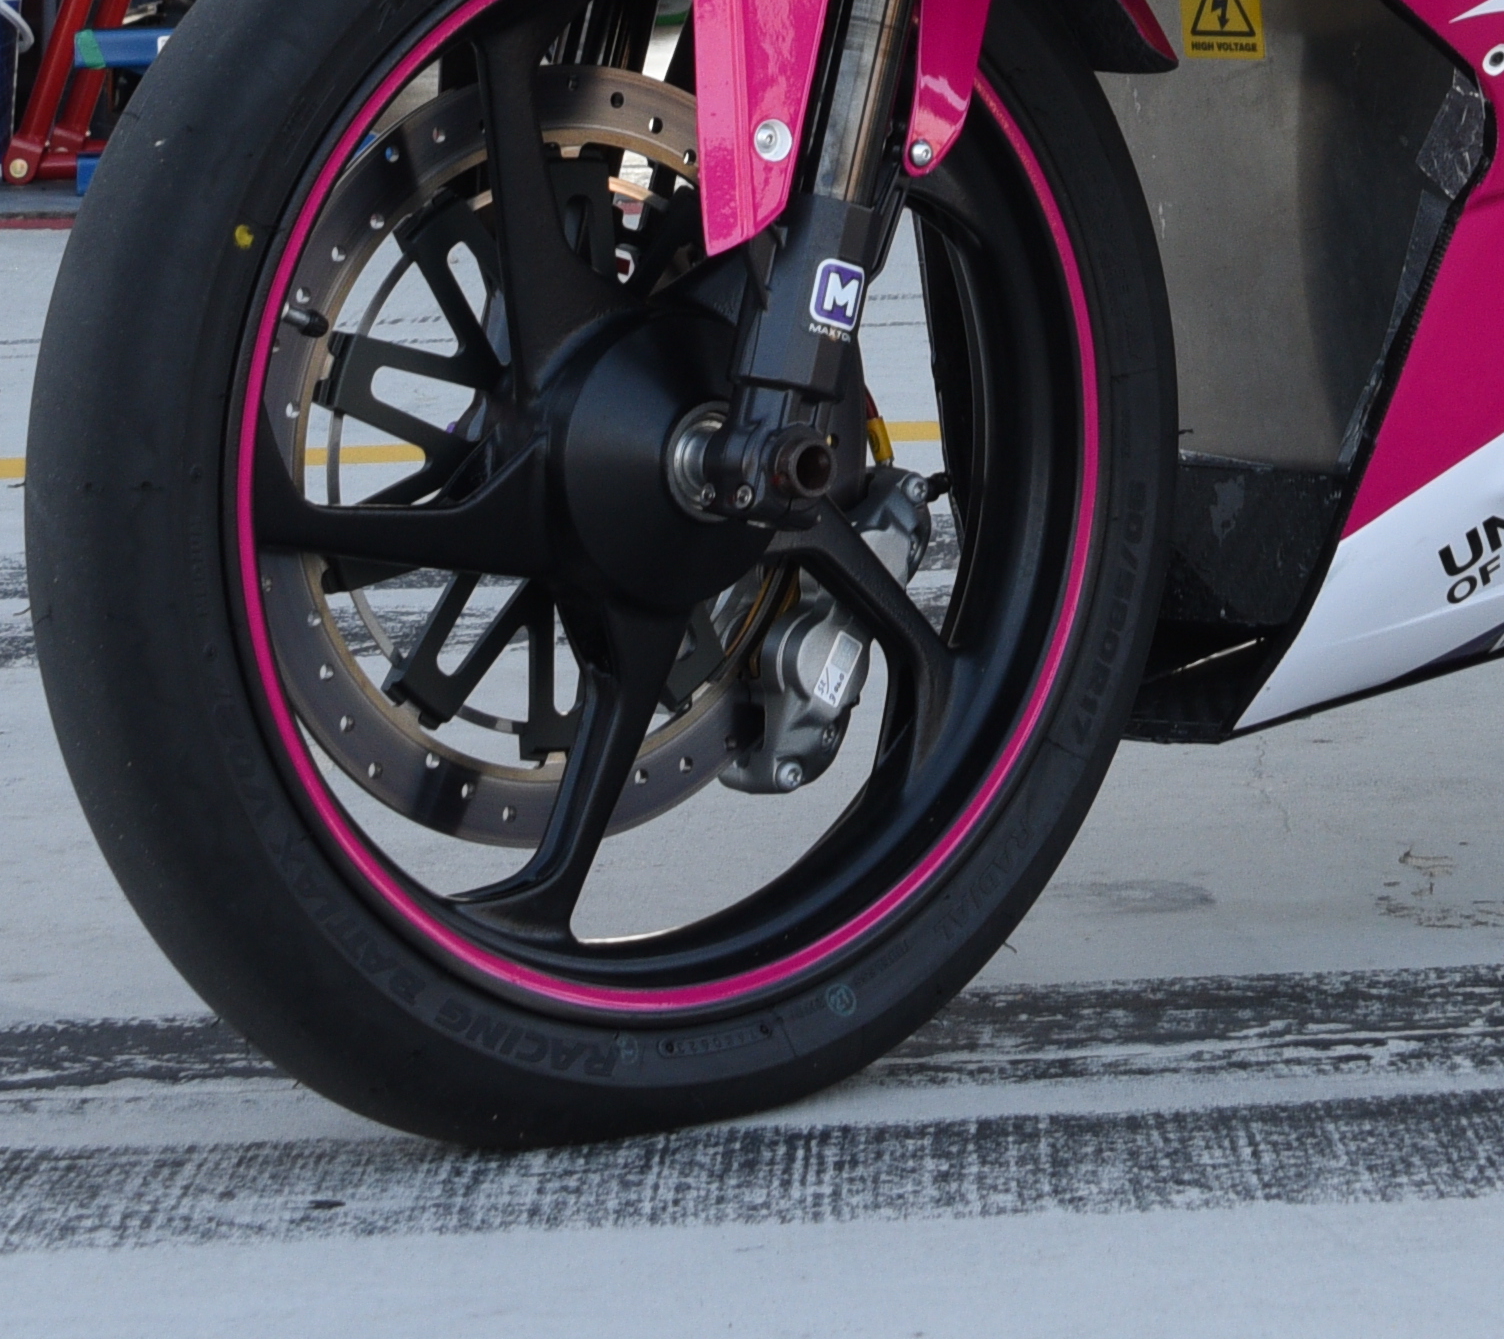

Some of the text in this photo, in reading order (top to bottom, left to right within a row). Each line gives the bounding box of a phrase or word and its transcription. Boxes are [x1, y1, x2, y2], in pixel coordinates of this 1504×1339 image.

[1191, 41, 1258, 53] HIGH VOLTAGE
[823, 272, 859, 317] M
[809, 323, 852, 343] MAXTO
[1447, 553, 1502, 604] OF
